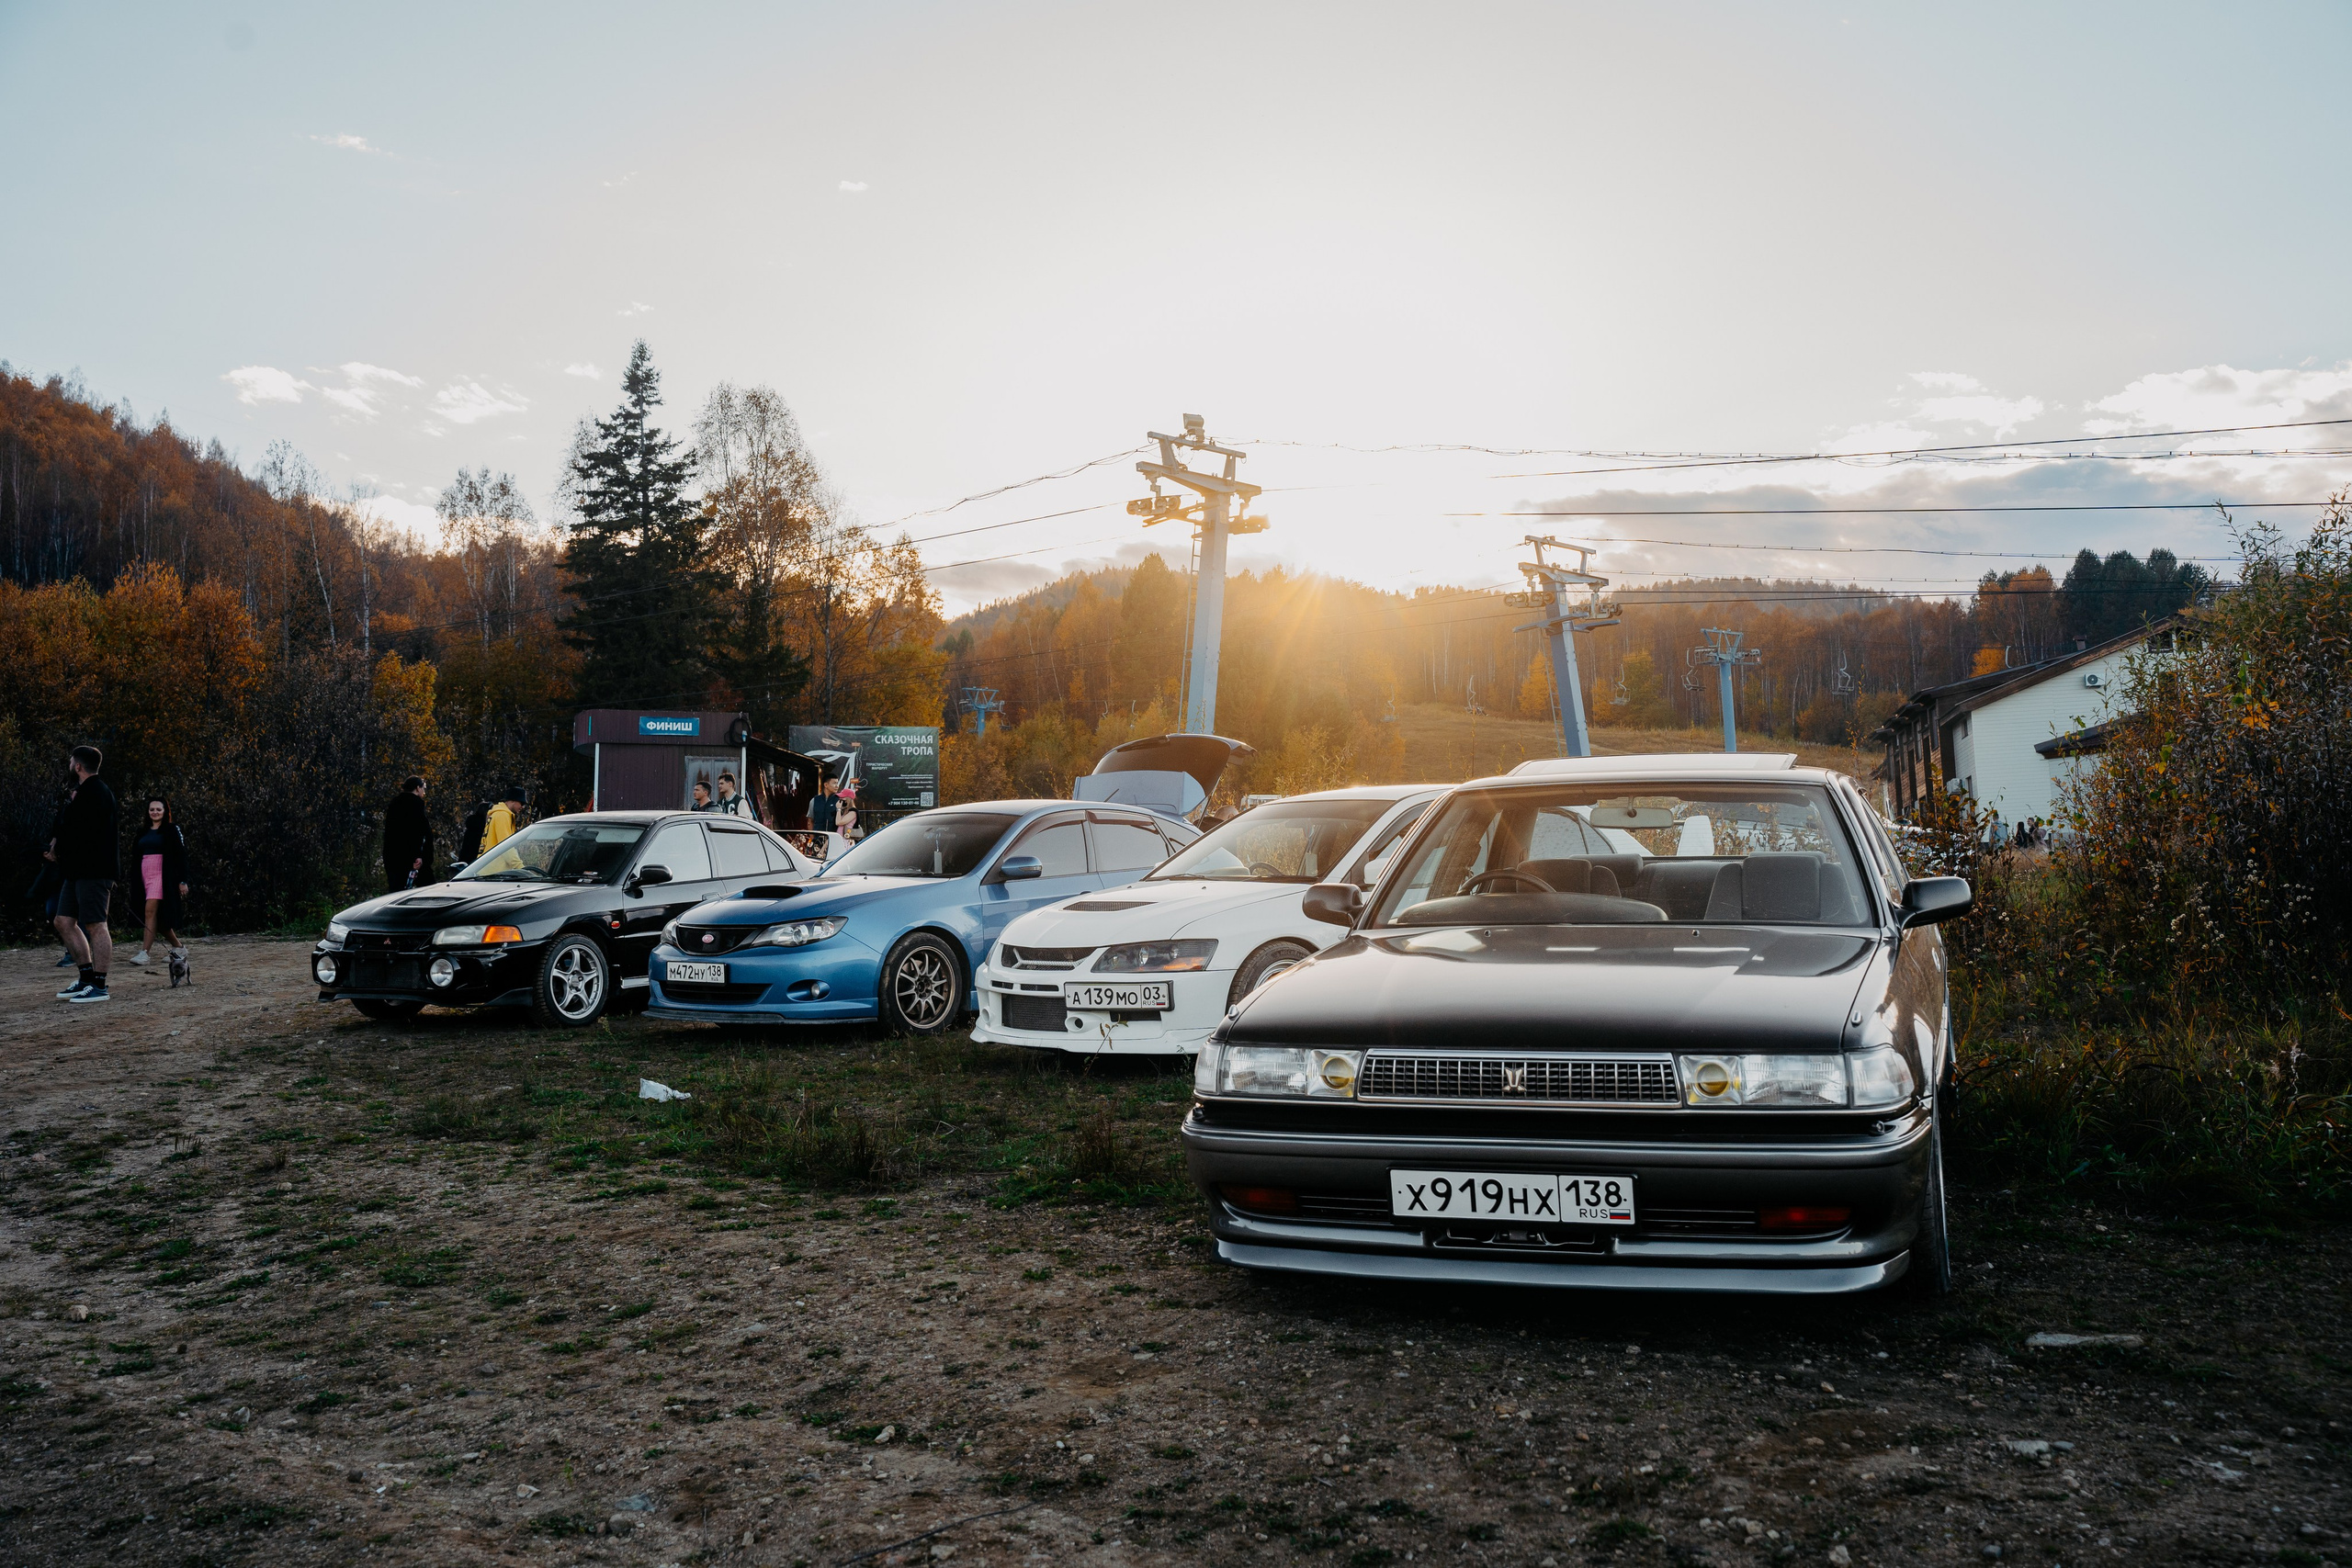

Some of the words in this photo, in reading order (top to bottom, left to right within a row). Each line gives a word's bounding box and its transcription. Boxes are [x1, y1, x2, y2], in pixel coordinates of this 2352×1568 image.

[646, 721, 693, 731] ФИНИШ
[875, 735, 933, 744] СКАЗОЧНАЯ
[900, 746, 933, 756] ТРОПА
[669, 964, 705, 980] М472НУ
[707, 965, 722, 977] 138
[1072, 987, 1138, 1006] А139МО
[1142, 987, 1161, 1000] 03
[1406, 1177, 1556, 1216] Х919НХ
[1565, 1179, 1623, 1207] 138
[1579, 1209, 1608, 1219] RUS
